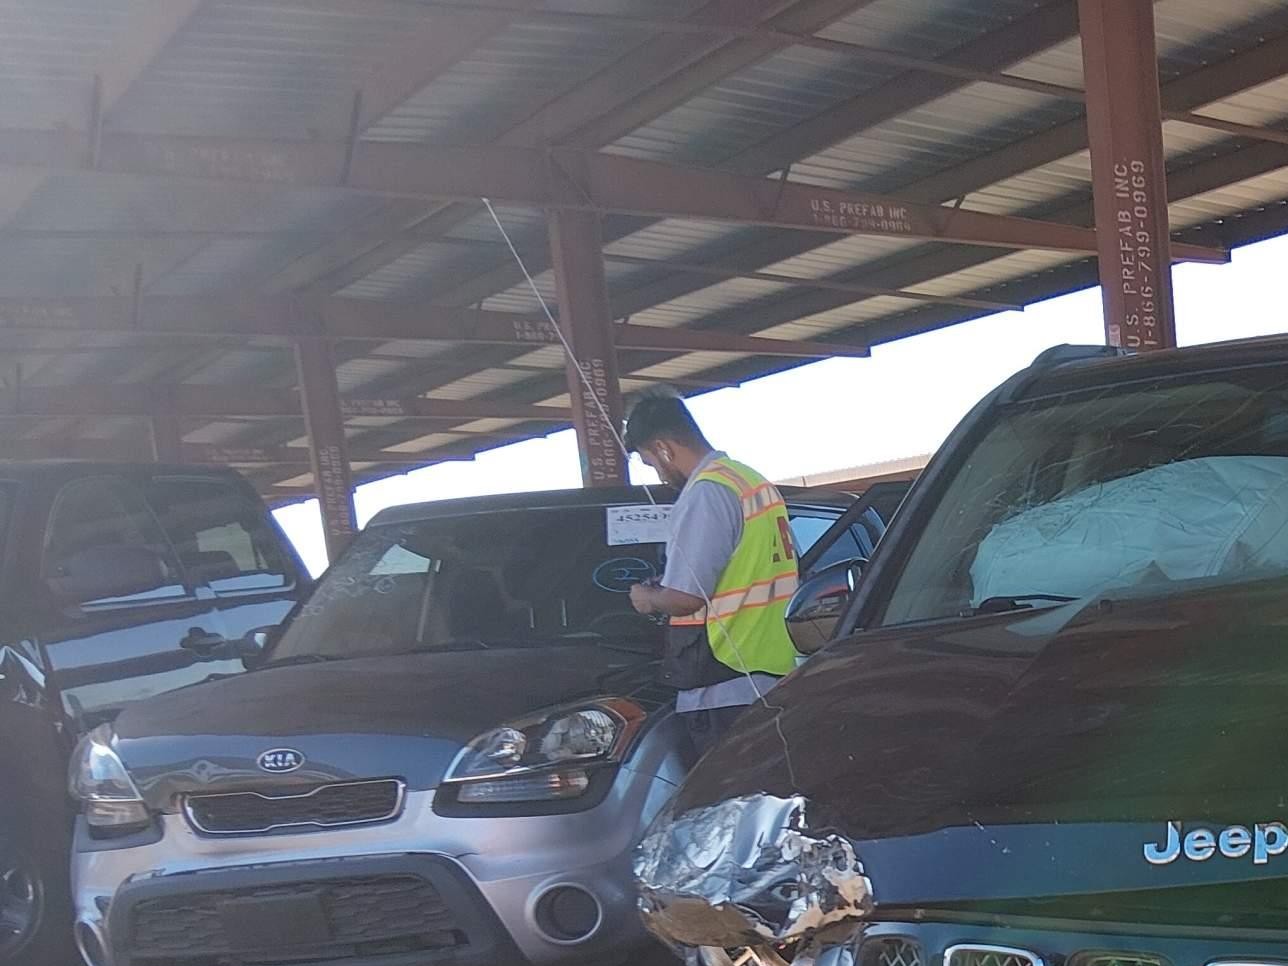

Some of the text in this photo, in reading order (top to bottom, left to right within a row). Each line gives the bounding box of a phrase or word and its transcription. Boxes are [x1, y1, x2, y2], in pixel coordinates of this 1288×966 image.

[1117, 209, 1137, 294] PREFAB
[1131, 159, 1158, 346] 1-866-799-0969
[1126, 308, 1141, 348] U.S.
[264, 752, 297, 767] KIA
